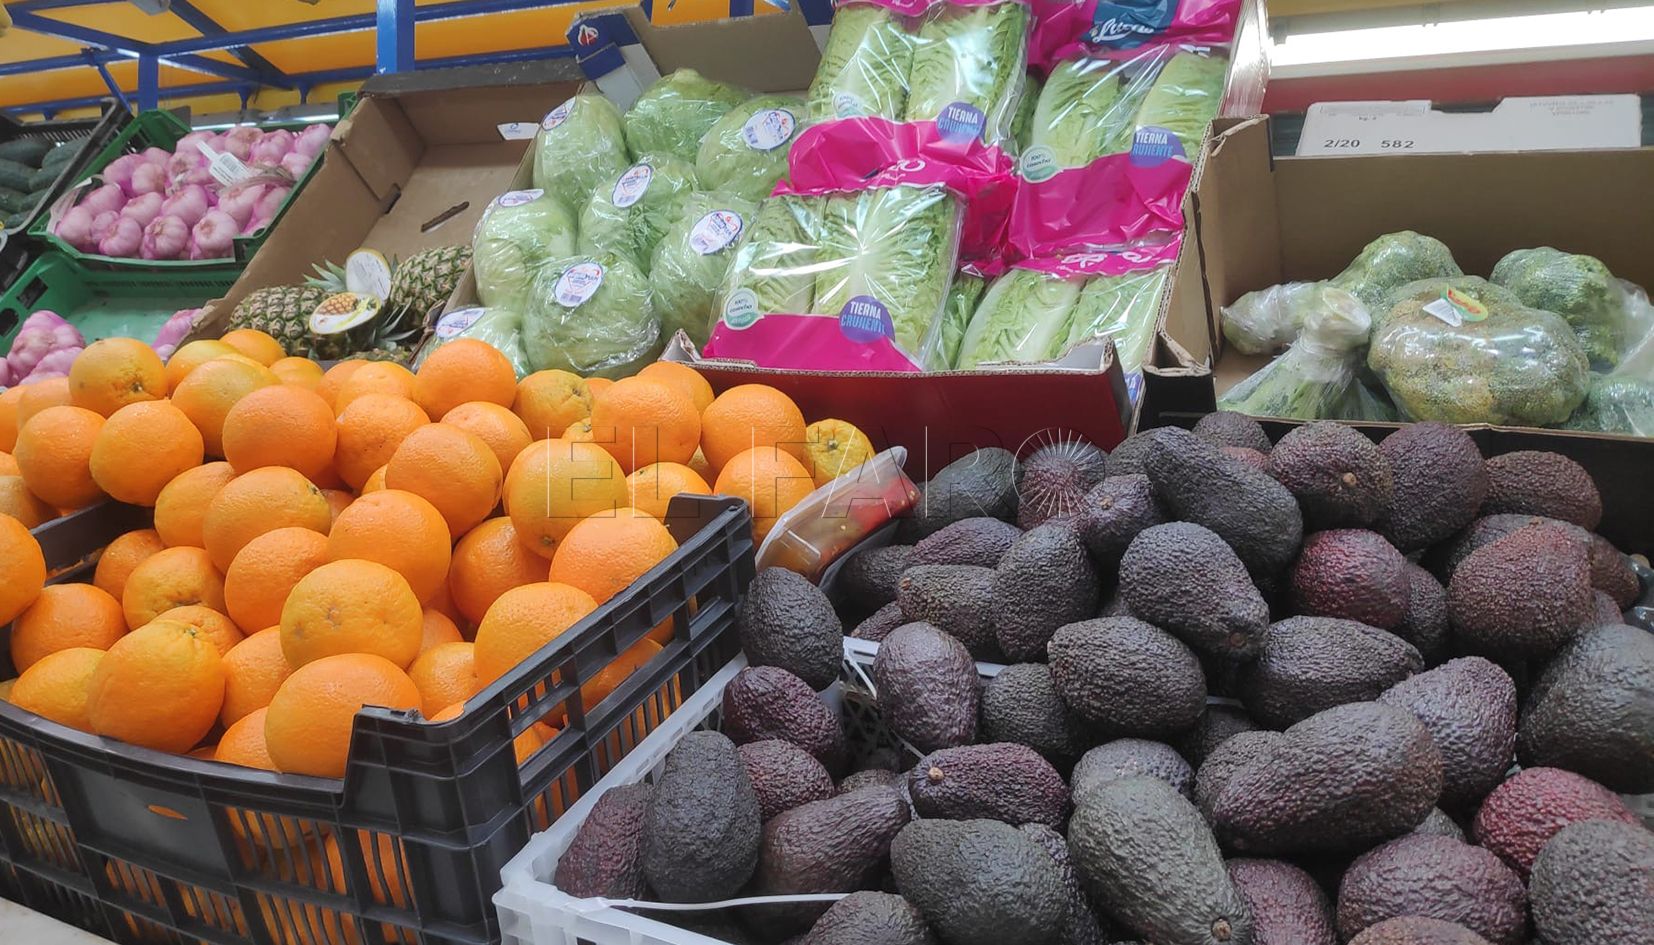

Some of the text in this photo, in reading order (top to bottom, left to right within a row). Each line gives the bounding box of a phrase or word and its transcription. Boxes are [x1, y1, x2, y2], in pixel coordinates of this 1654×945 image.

[948, 106, 978, 125] TIERNA
[1136, 131, 1168, 145] TIERNA
[1324, 139, 1415, 149] 2/20 582
[1132, 143, 1174, 157] RUJIENTE
[850, 301, 881, 320] TIERNA
